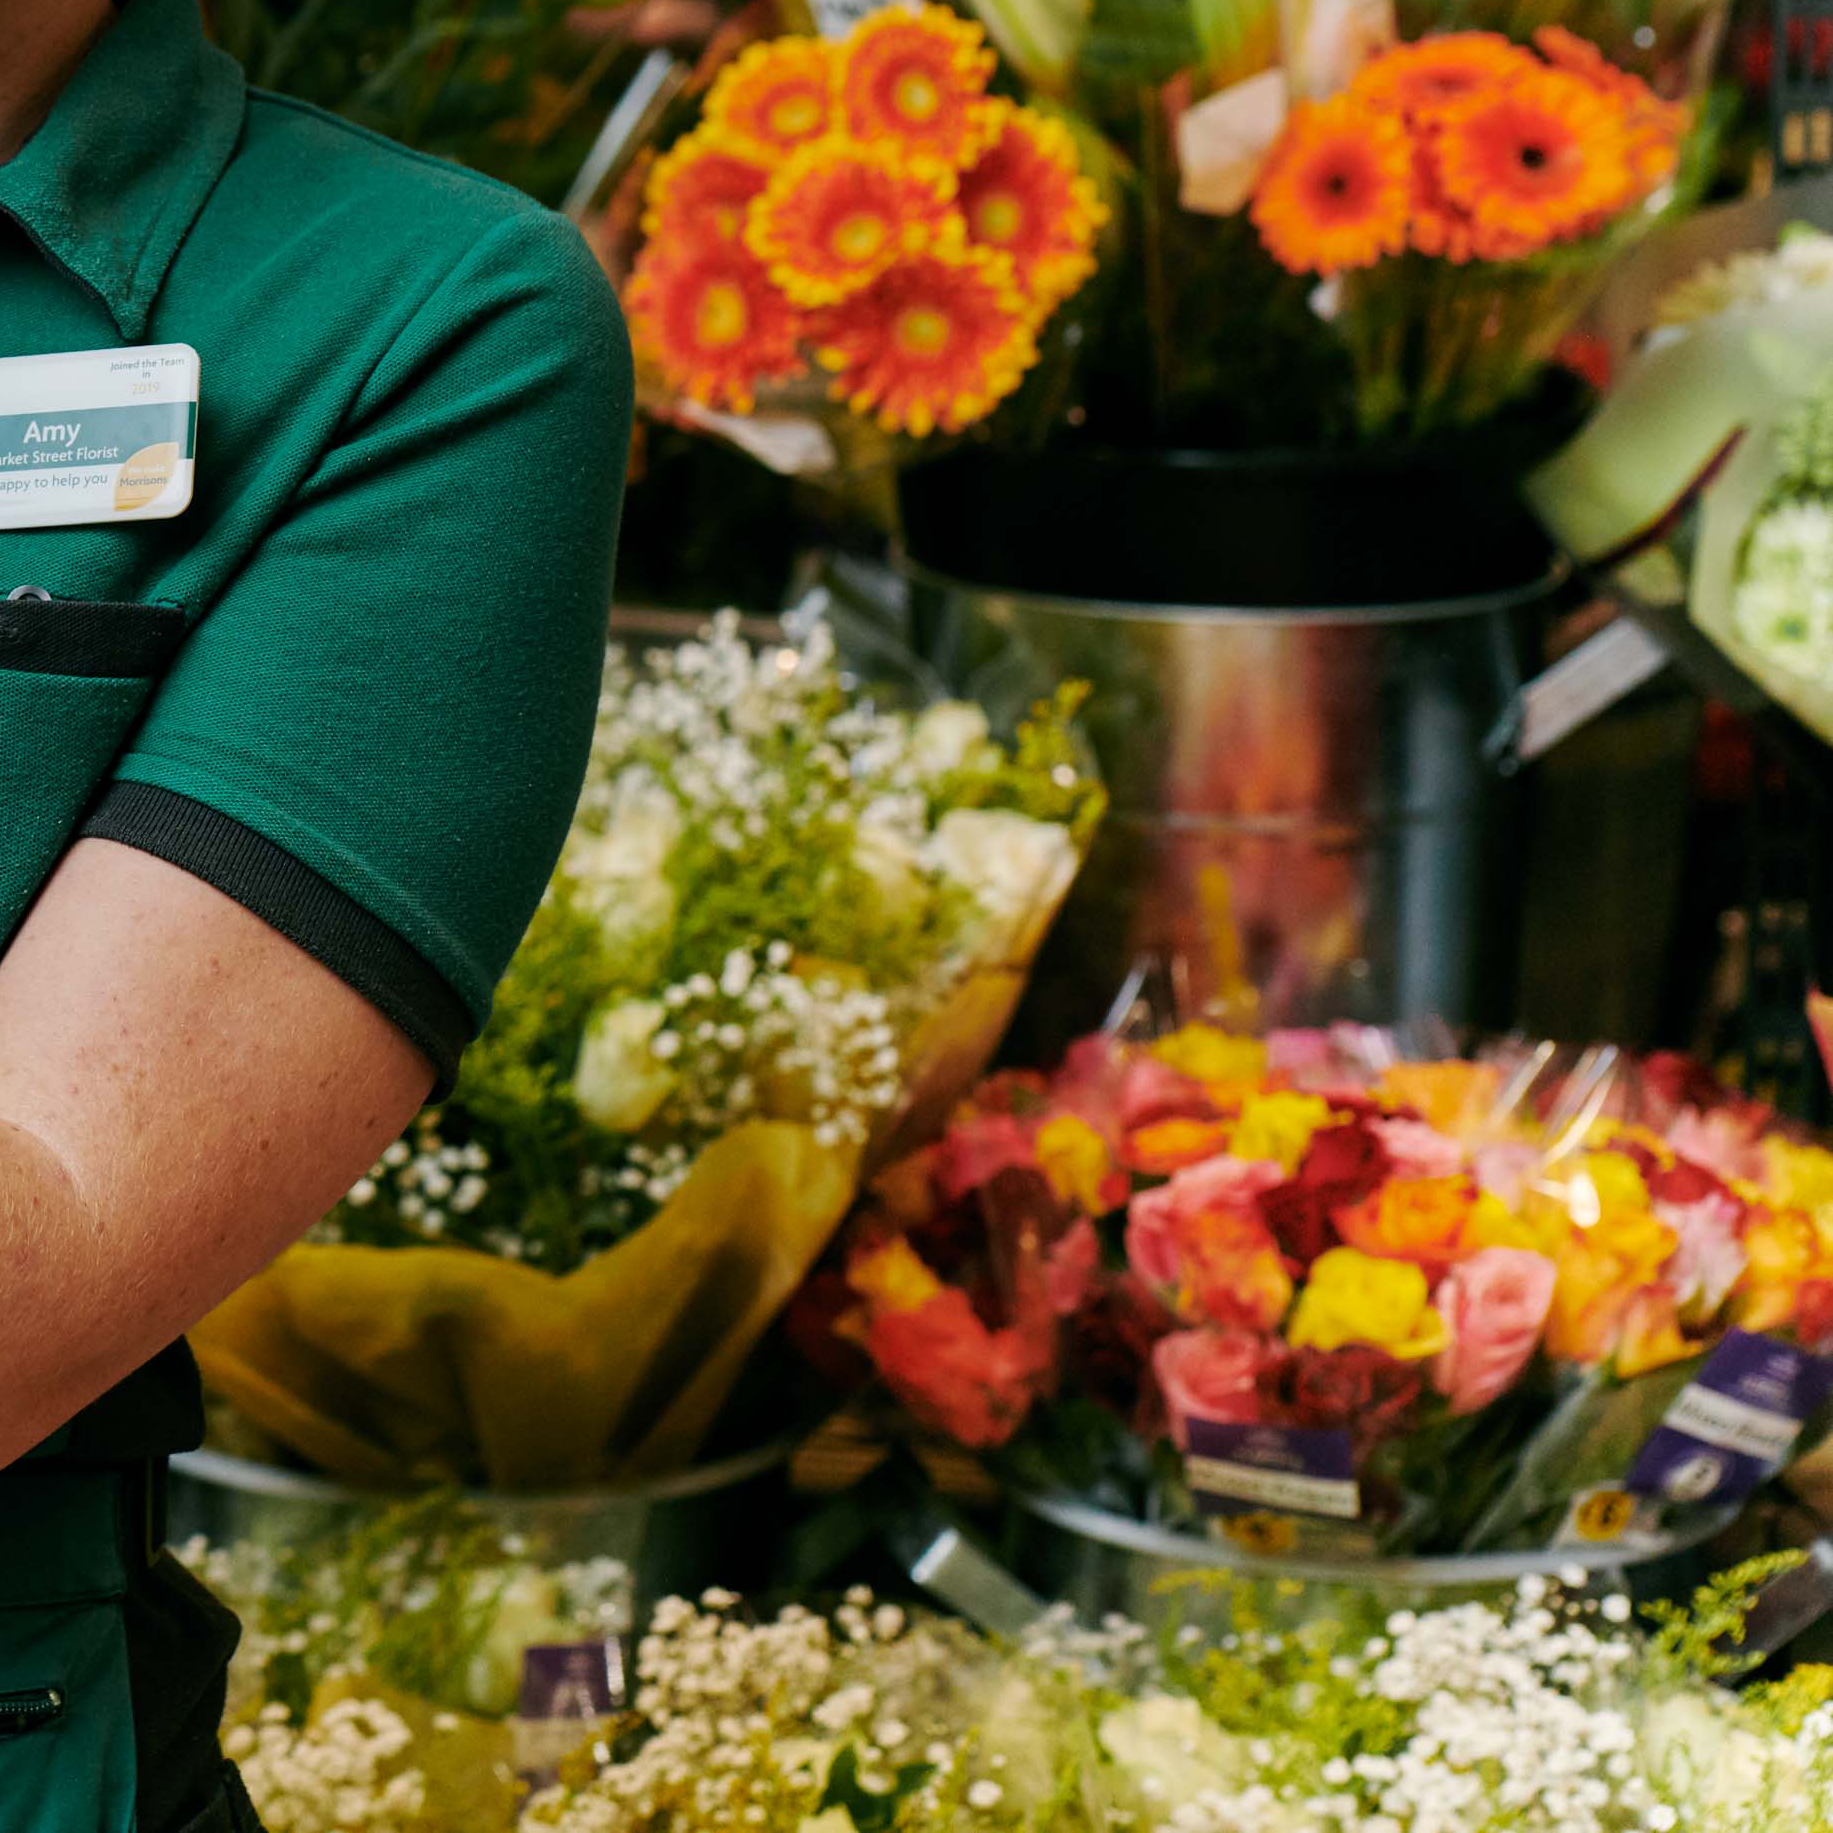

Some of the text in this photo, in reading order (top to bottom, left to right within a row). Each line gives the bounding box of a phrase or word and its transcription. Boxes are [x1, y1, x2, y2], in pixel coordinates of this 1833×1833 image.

[110, 356, 185, 372] Joined the Team
[142, 370, 151, 379] in
[23, 421, 81, 447] Amy
[32, 448, 74, 464] Street
[76, 446, 119, 461] Florist
[35, 476, 48, 488] to
[52, 473, 80, 490] help
[84, 475, 109, 489] you
[119, 477, 168, 487] Morrisons
